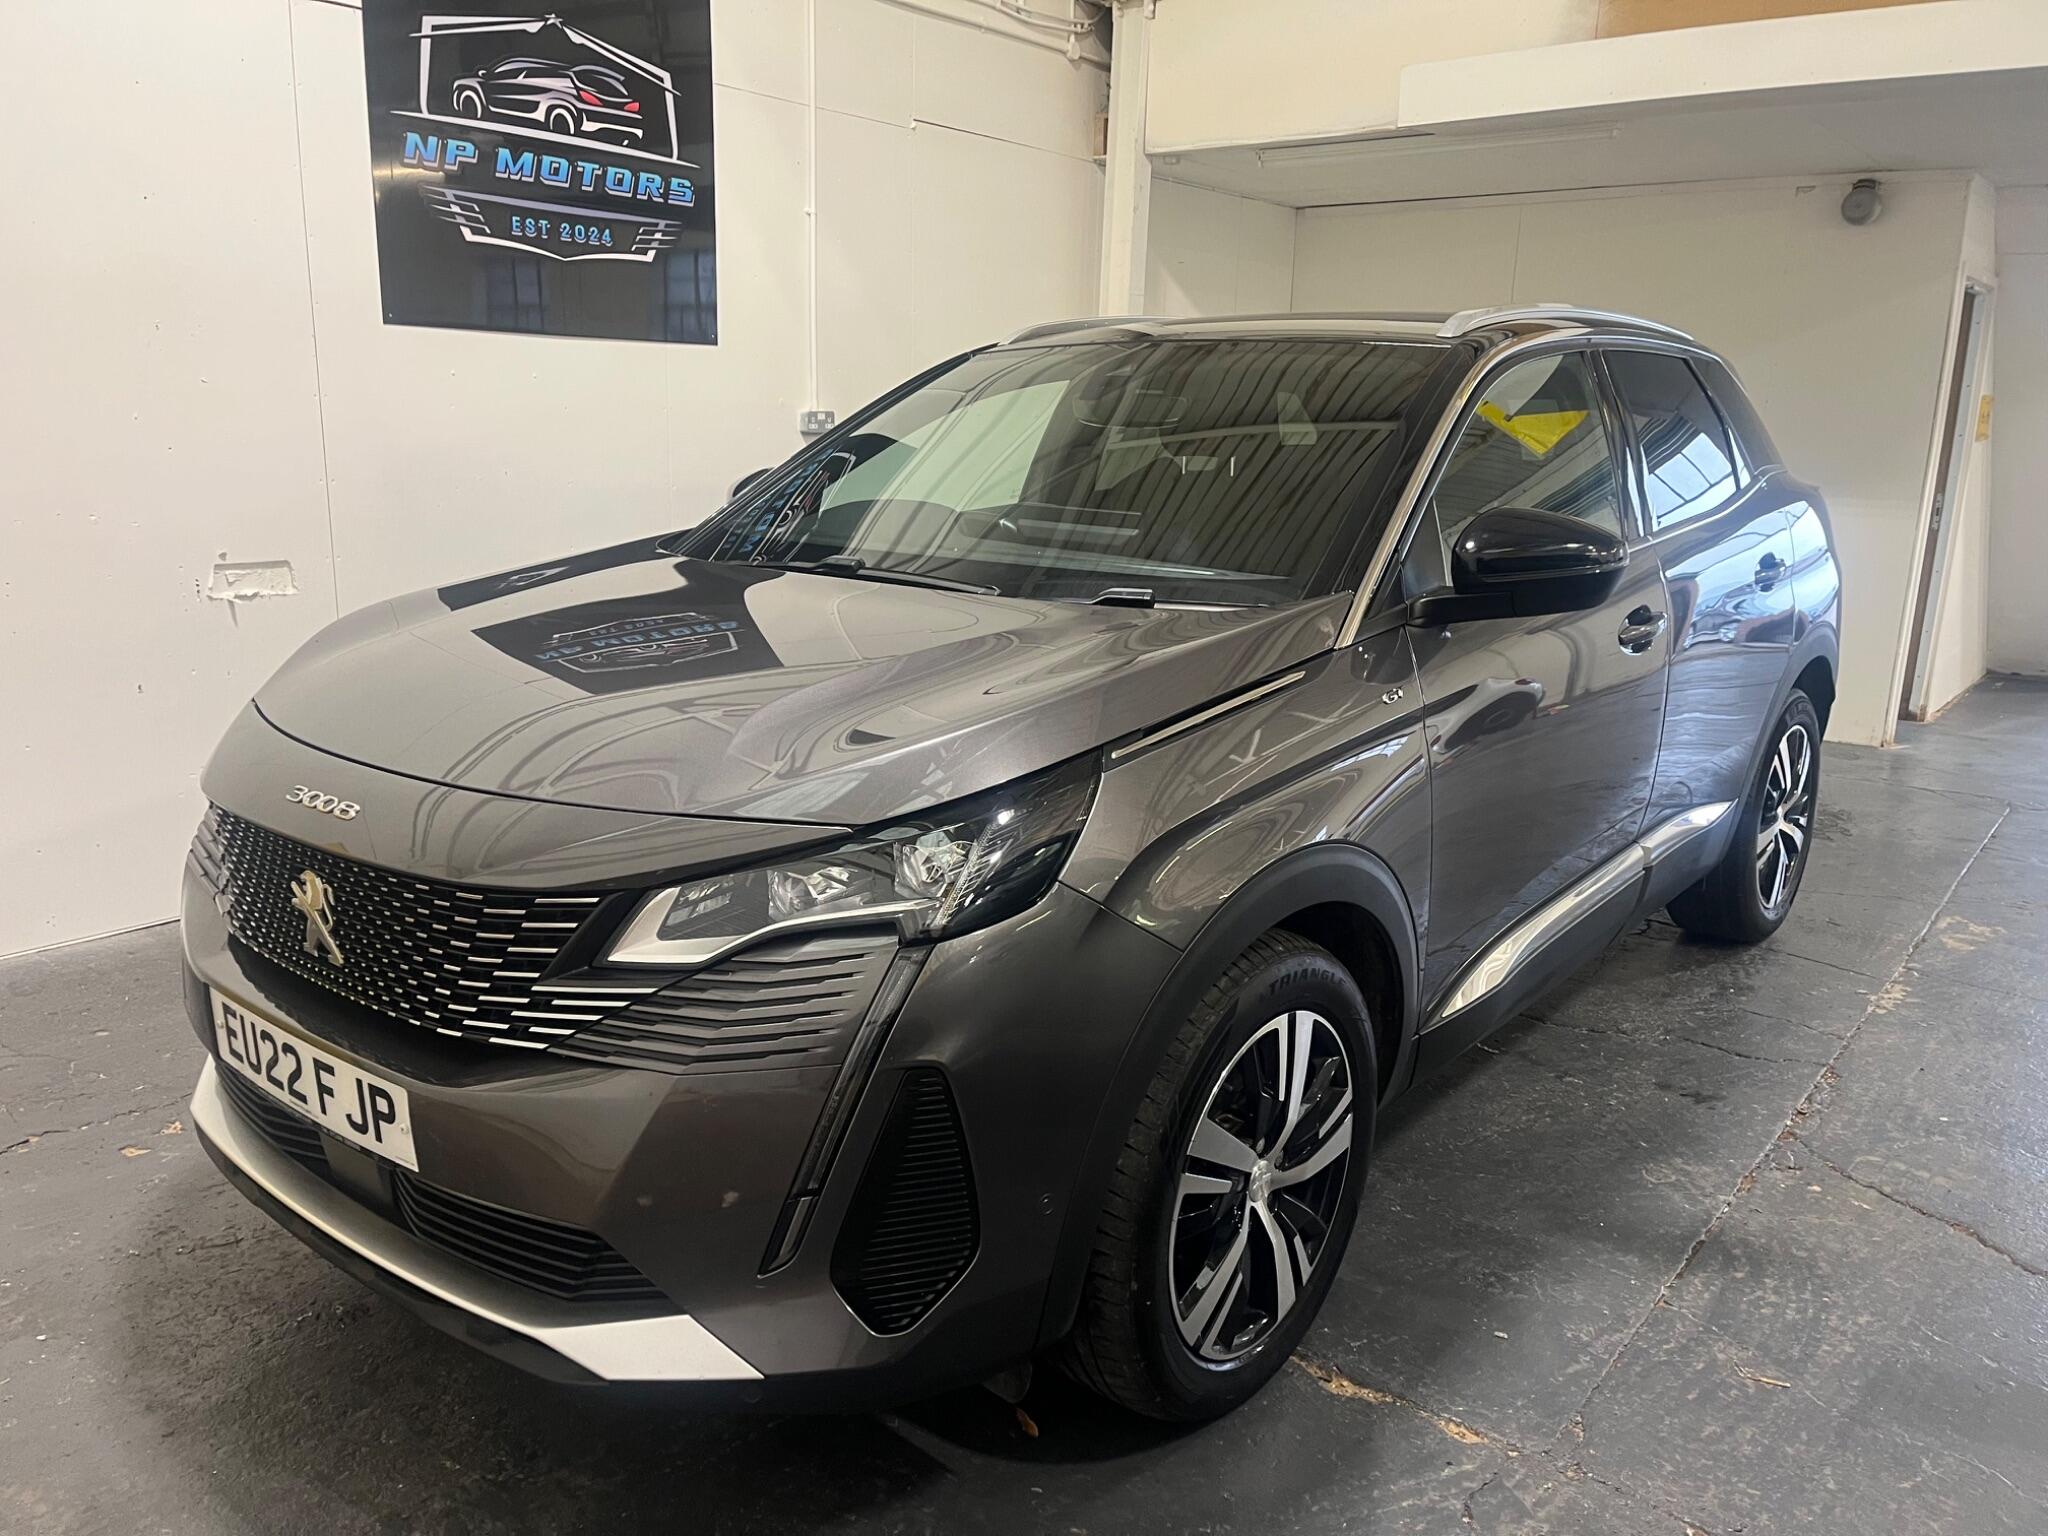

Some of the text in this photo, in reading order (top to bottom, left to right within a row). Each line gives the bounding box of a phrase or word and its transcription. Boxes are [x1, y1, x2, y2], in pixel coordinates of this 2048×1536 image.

[403, 131, 696, 207] NP MOTORS
[511, 215, 614, 247] EST 2024
[285, 785, 361, 820] 3008
[222, 1002, 308, 1105] EU22
